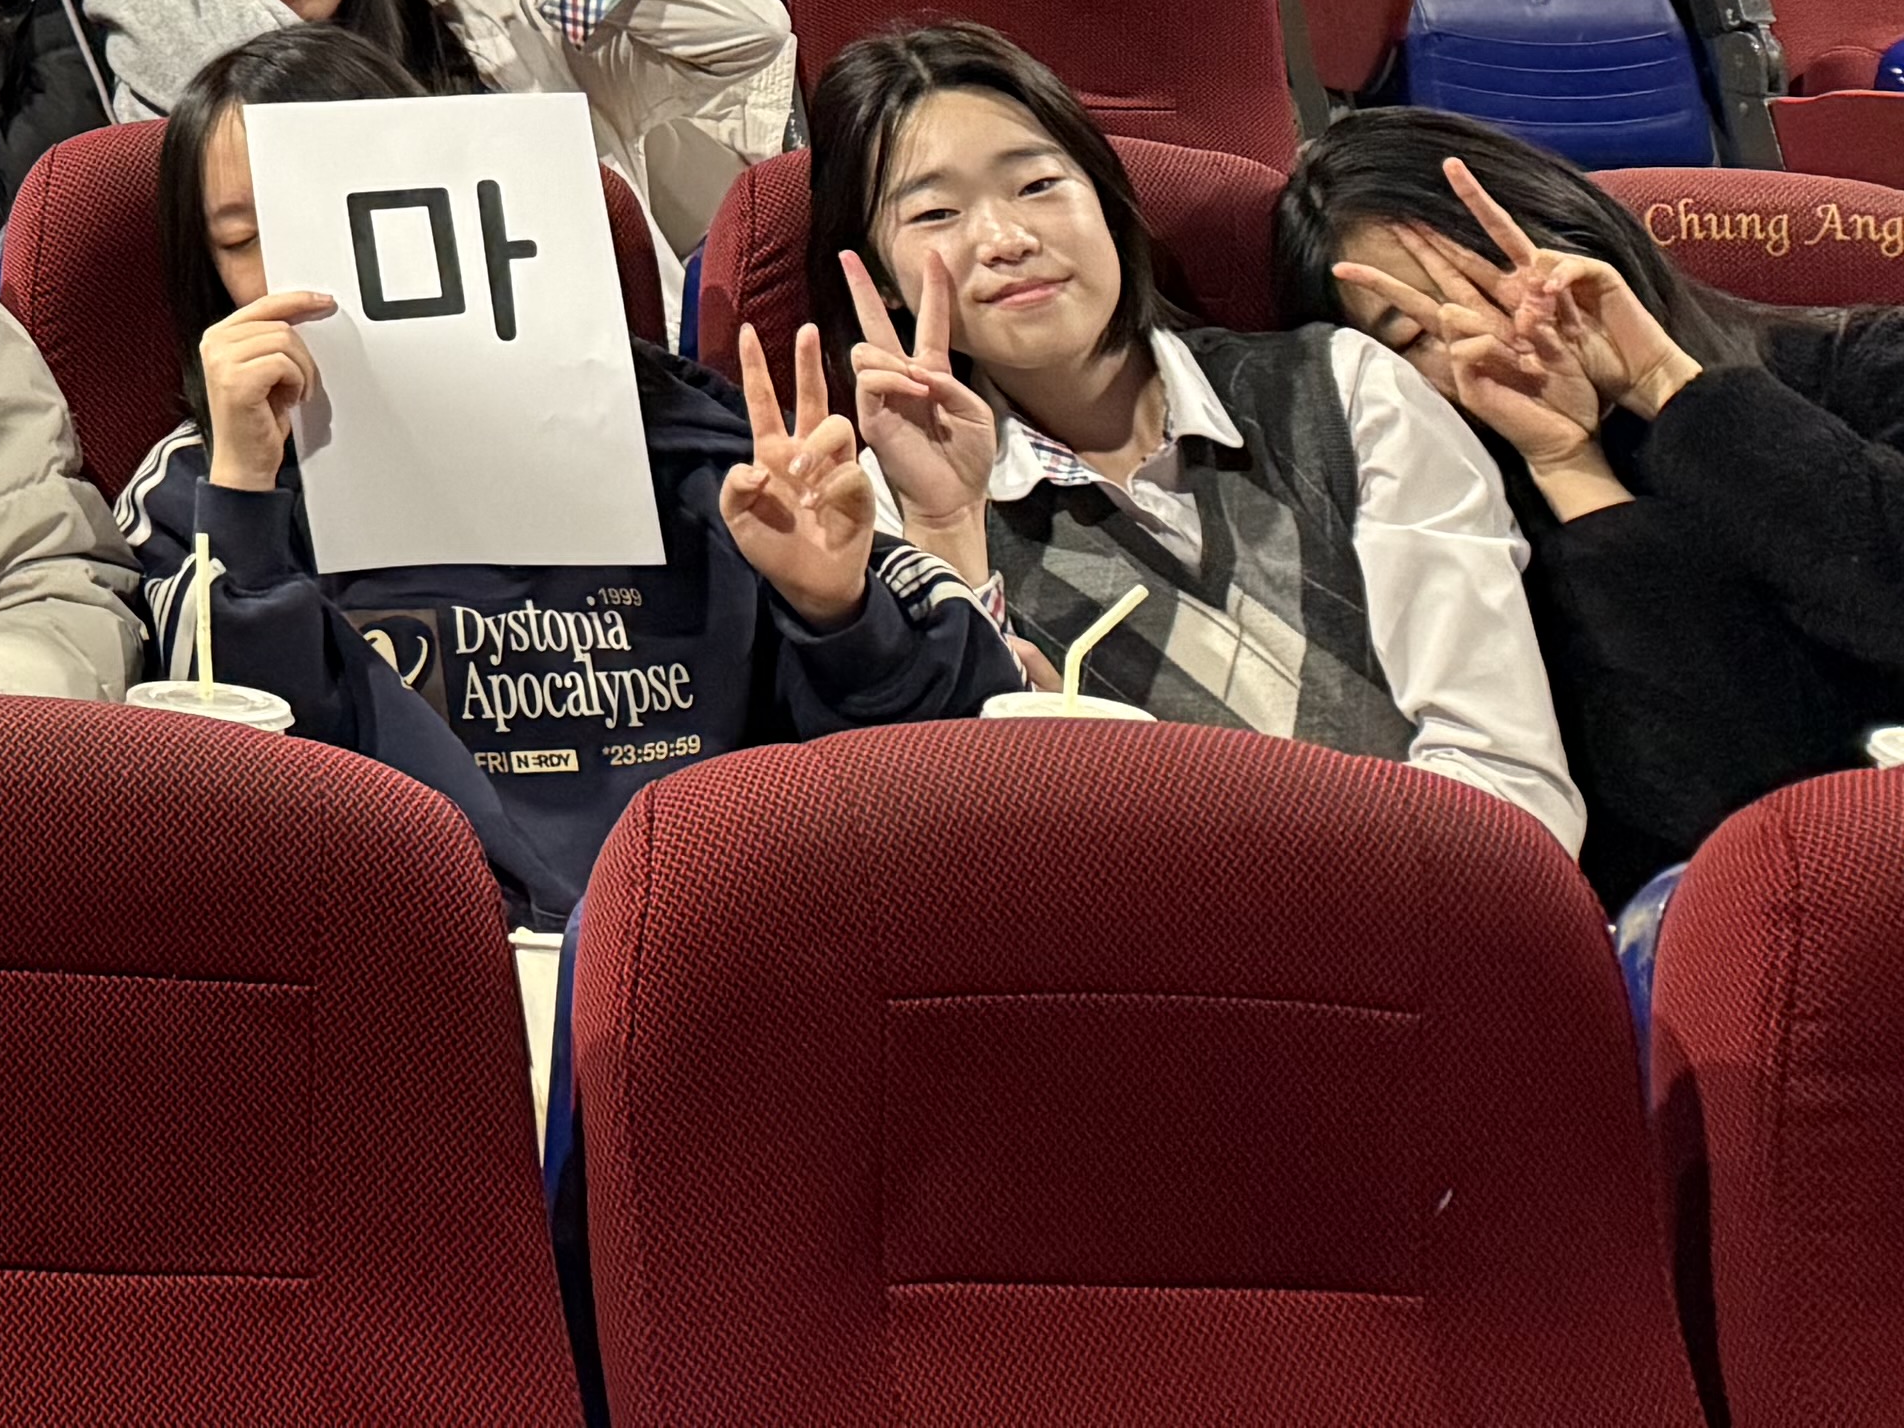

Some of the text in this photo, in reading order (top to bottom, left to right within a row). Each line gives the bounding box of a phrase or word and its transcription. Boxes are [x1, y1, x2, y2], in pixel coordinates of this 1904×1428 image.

[345, 179, 538, 342] 마
[1644, 198, 1904, 258] Chung Ang
[450, 595, 632, 667] Dystopia
[597, 587, 642, 607] 1999
[461, 653, 694, 733] Apocalypse
